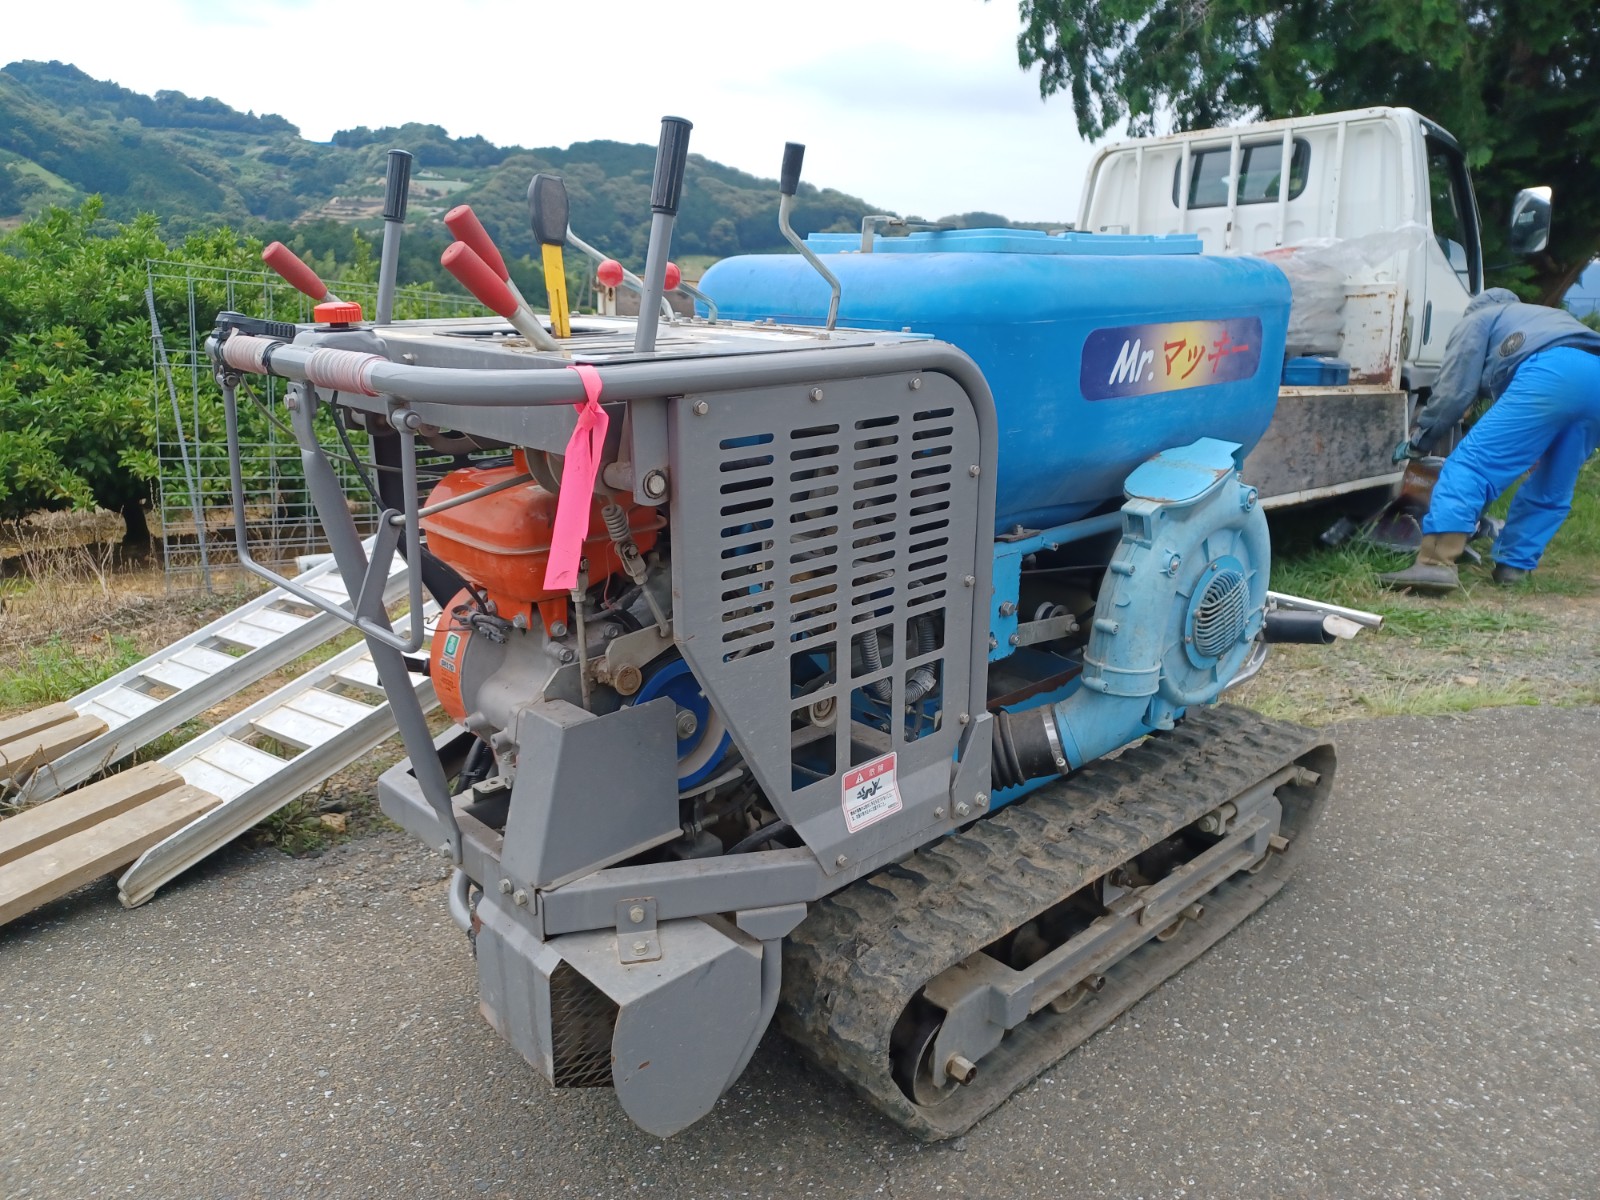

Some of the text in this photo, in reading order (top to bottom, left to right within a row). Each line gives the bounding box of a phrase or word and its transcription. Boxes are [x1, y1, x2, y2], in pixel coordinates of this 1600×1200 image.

[1109, 329, 1249, 385] Mr. マッキー
